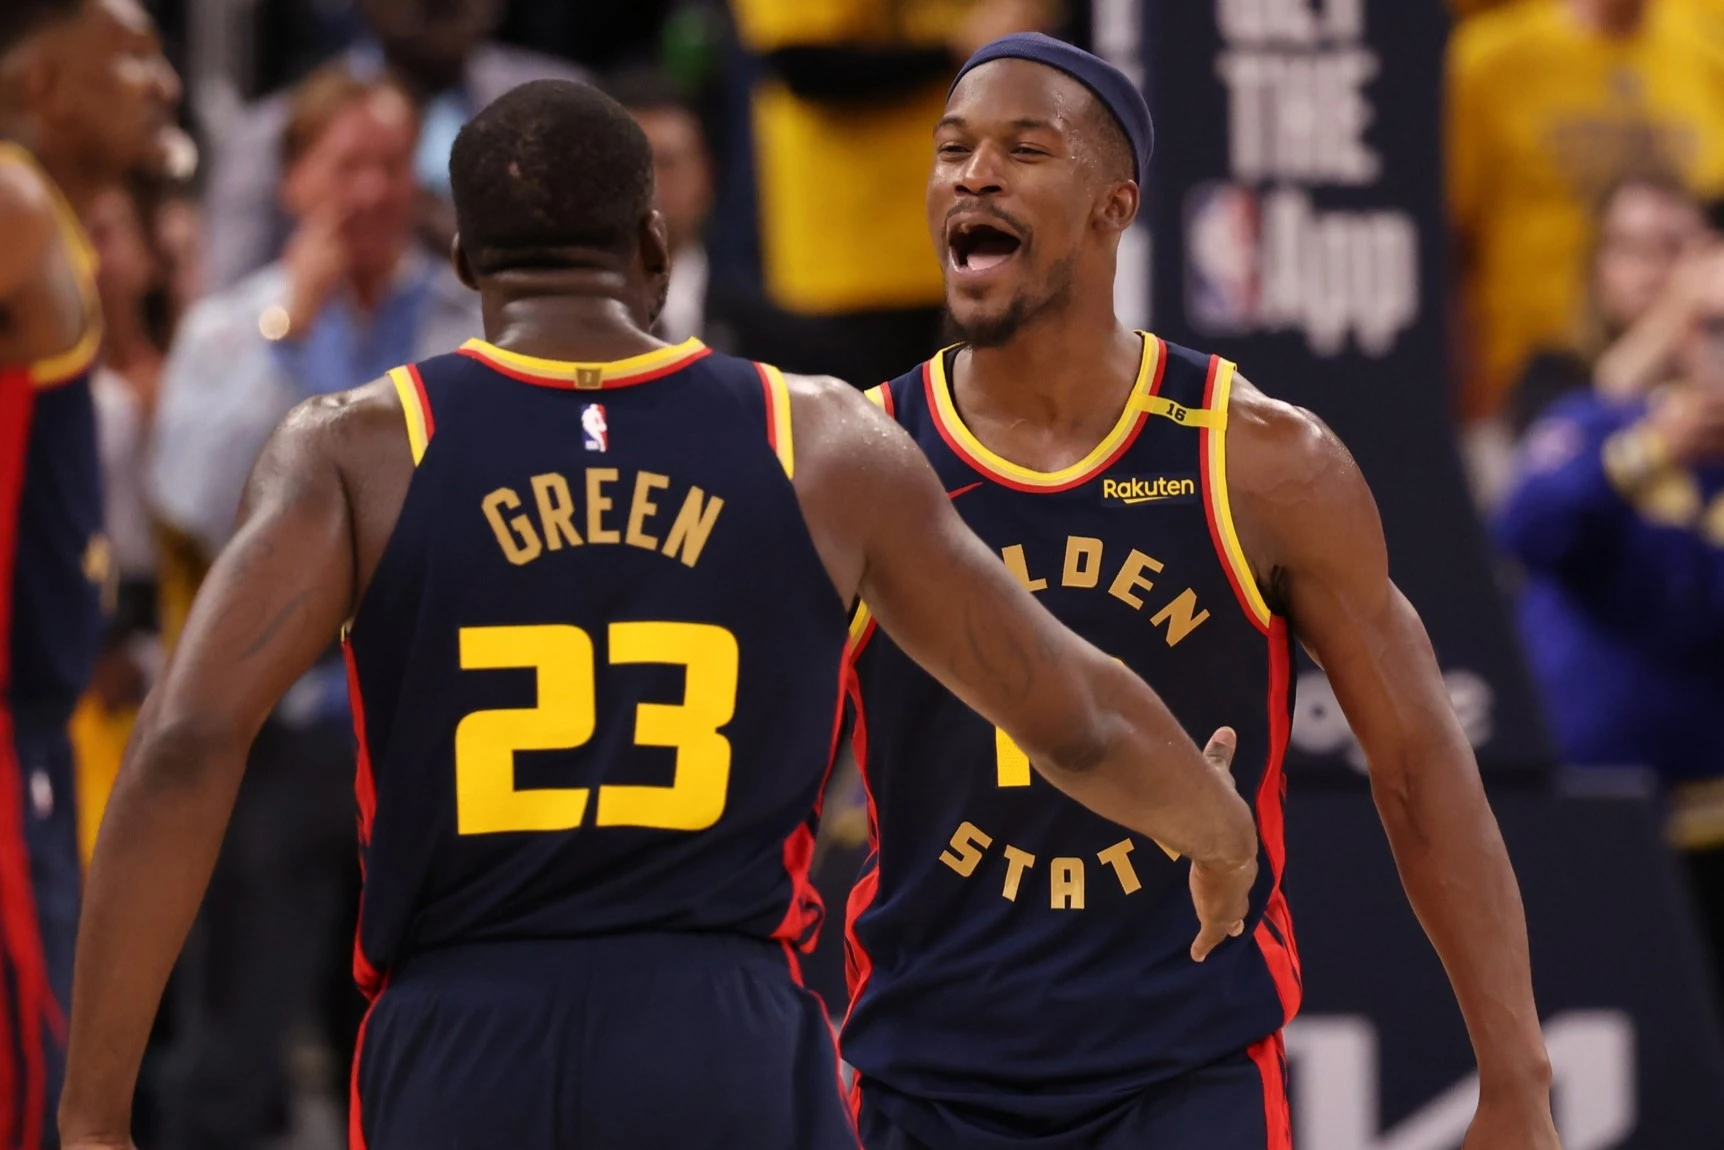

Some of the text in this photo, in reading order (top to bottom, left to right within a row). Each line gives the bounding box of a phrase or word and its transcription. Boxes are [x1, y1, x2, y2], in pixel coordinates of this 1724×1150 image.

[1166, 403, 1187, 422] 16
[482, 468, 724, 568] GREEN
[1103, 477, 1195, 502] Rakuten
[1001, 535, 1211, 648] LDEN
[455, 621, 739, 835] 23
[939, 821, 1181, 910] STAT
